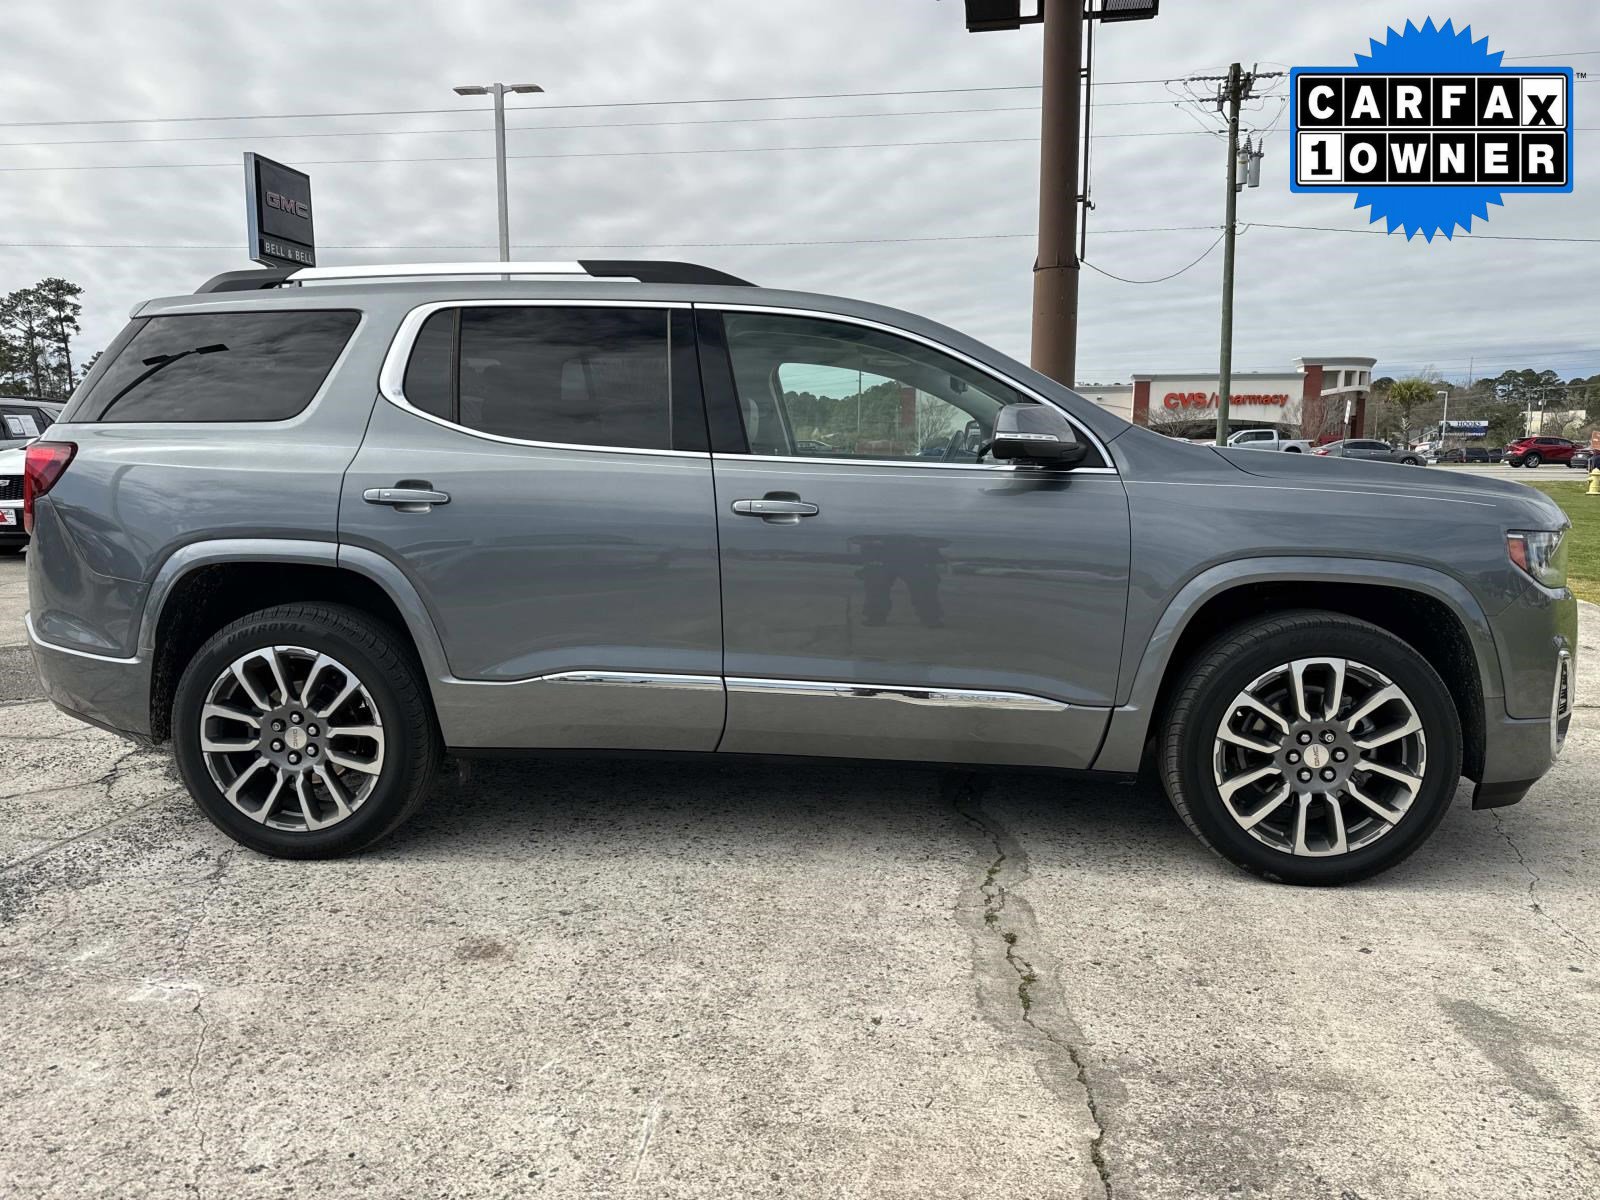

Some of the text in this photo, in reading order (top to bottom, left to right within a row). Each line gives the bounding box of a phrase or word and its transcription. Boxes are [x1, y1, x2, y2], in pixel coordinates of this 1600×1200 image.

[266, 191, 309, 219] GMC
[265, 242, 313, 264] BELL & BELL
